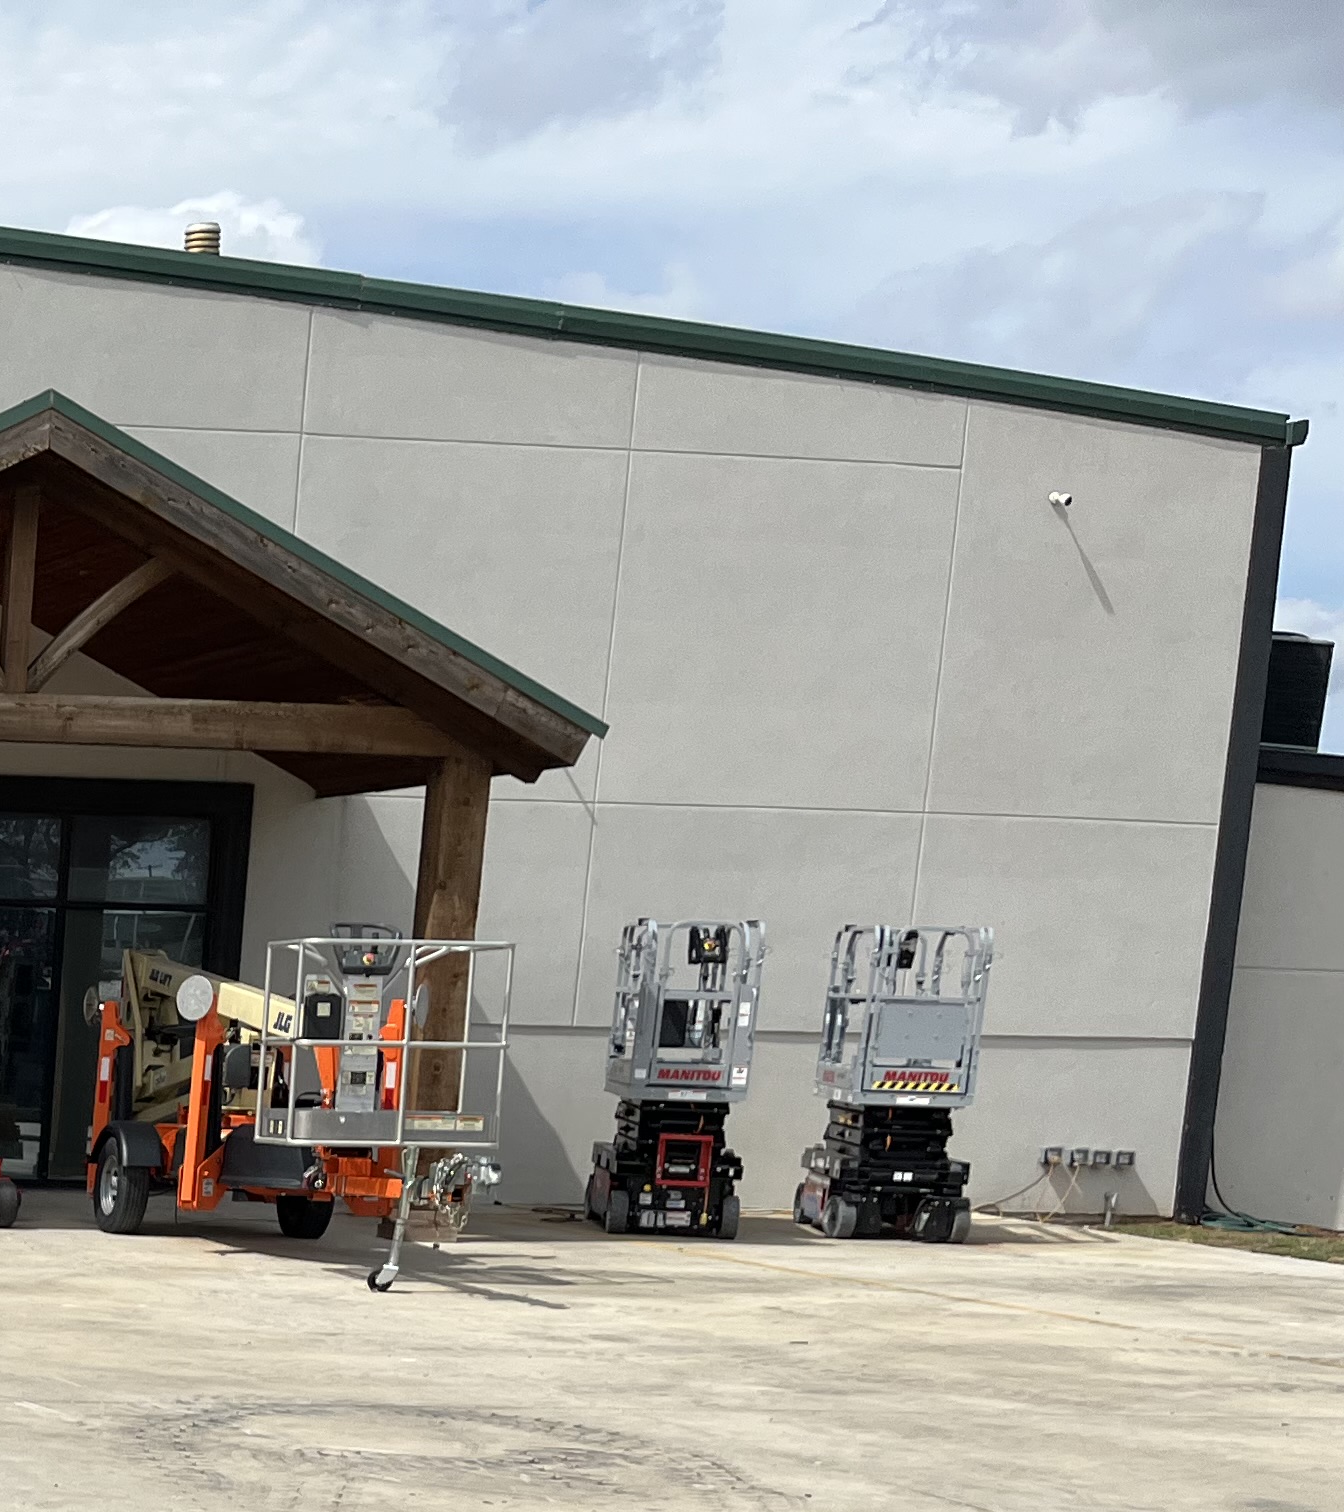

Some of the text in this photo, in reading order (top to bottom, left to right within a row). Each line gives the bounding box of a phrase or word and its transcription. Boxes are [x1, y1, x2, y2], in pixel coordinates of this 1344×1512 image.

[273, 1011, 294, 1034] JLG
[657, 1067, 723, 1082] MANITOU
[883, 1070, 950, 1083] MANITOU
